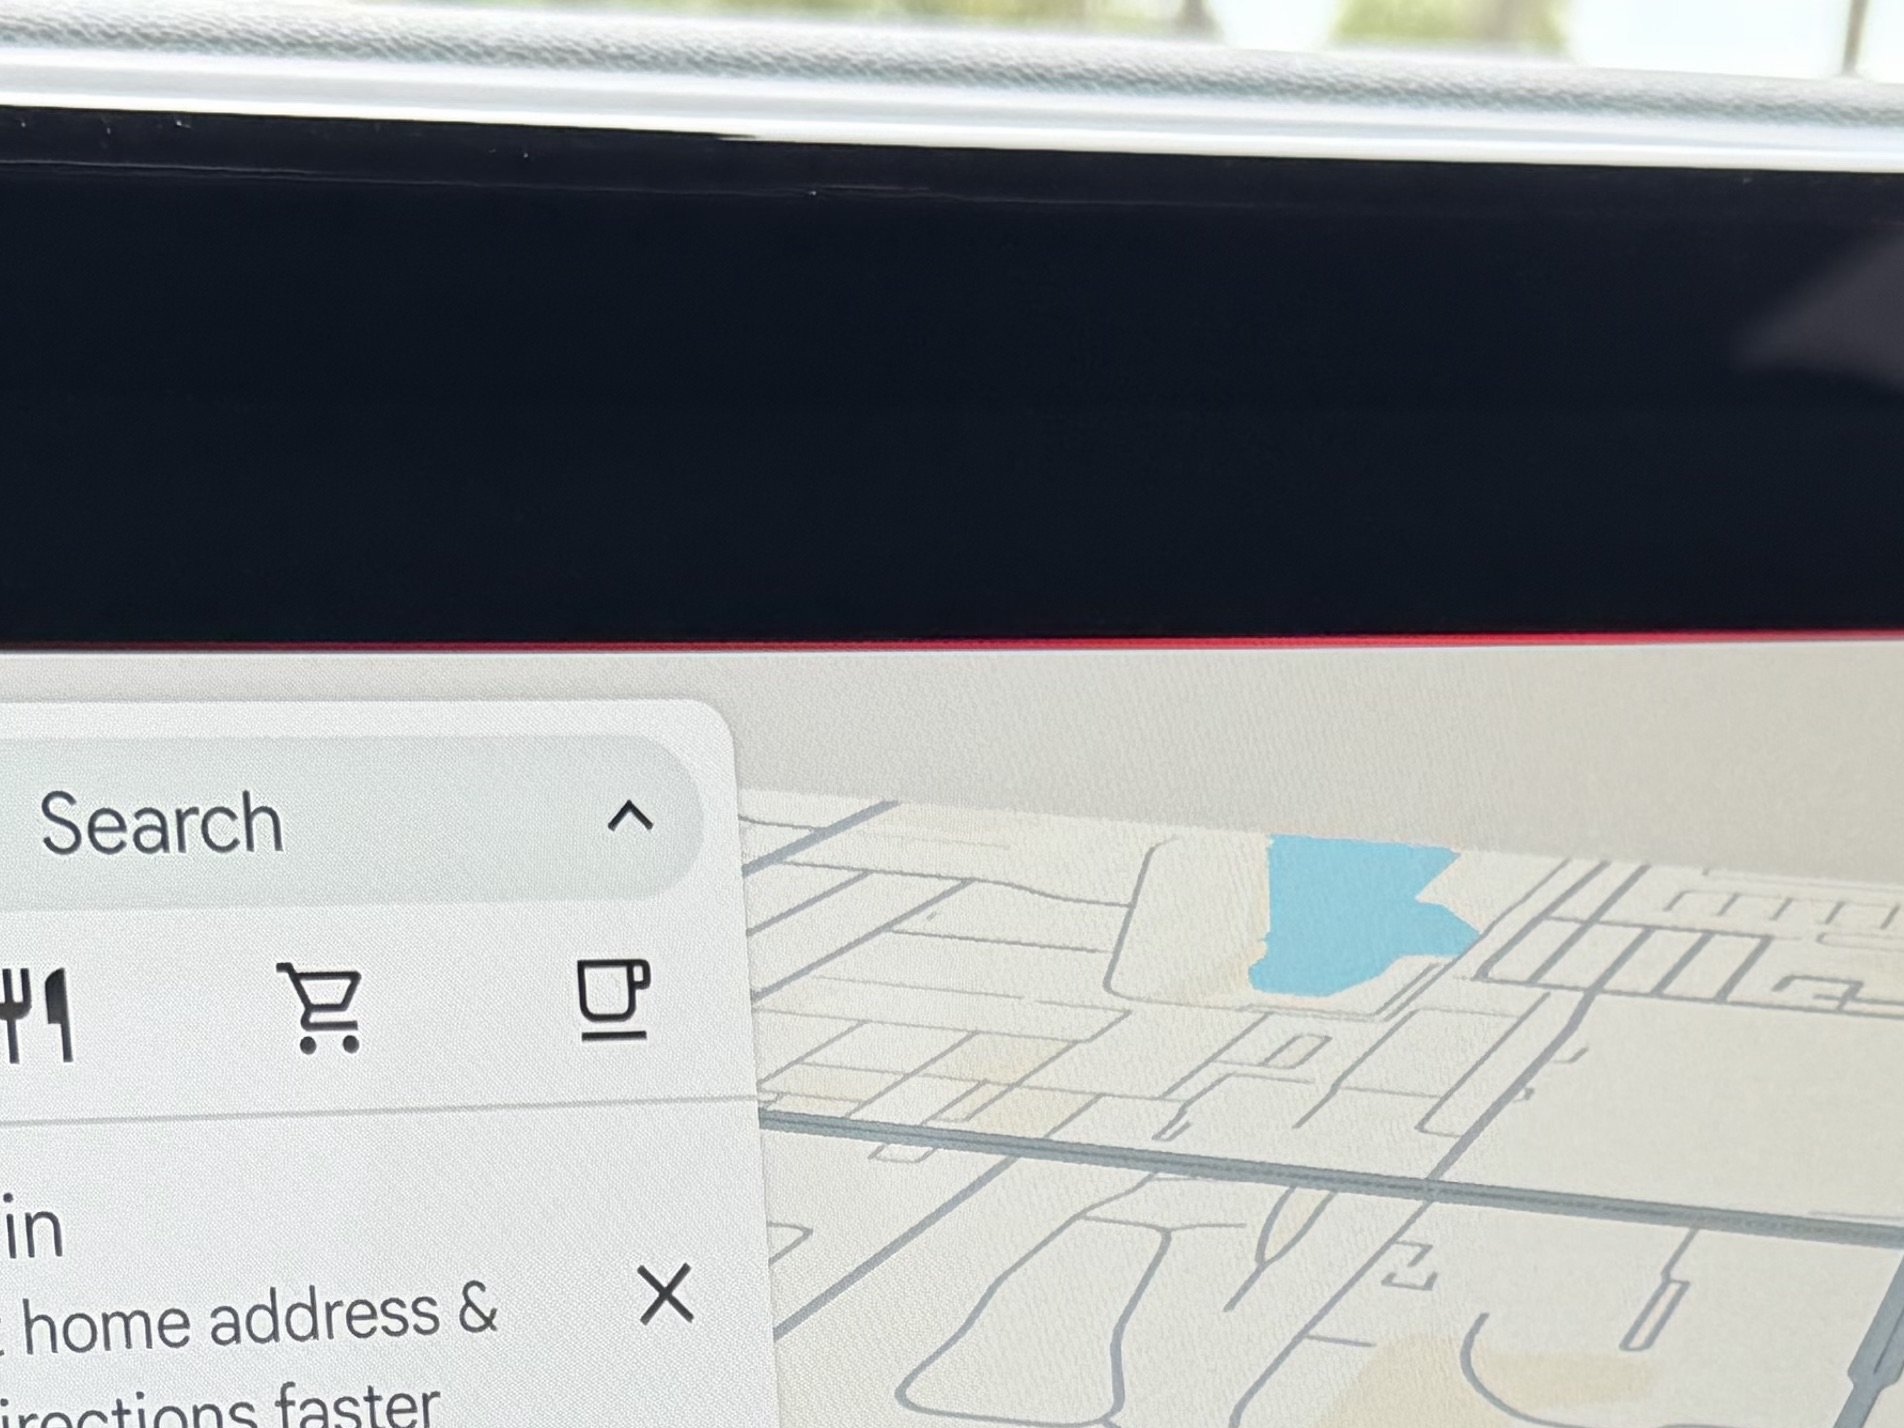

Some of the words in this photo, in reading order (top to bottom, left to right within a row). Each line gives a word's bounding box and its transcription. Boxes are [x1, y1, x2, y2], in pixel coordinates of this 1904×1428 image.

[40, 788, 284, 857] Search
[1, 1191, 64, 1260] in
[21, 1297, 192, 1356] home
[209, 1283, 441, 1348] address
[457, 1278, 499, 1335] &
